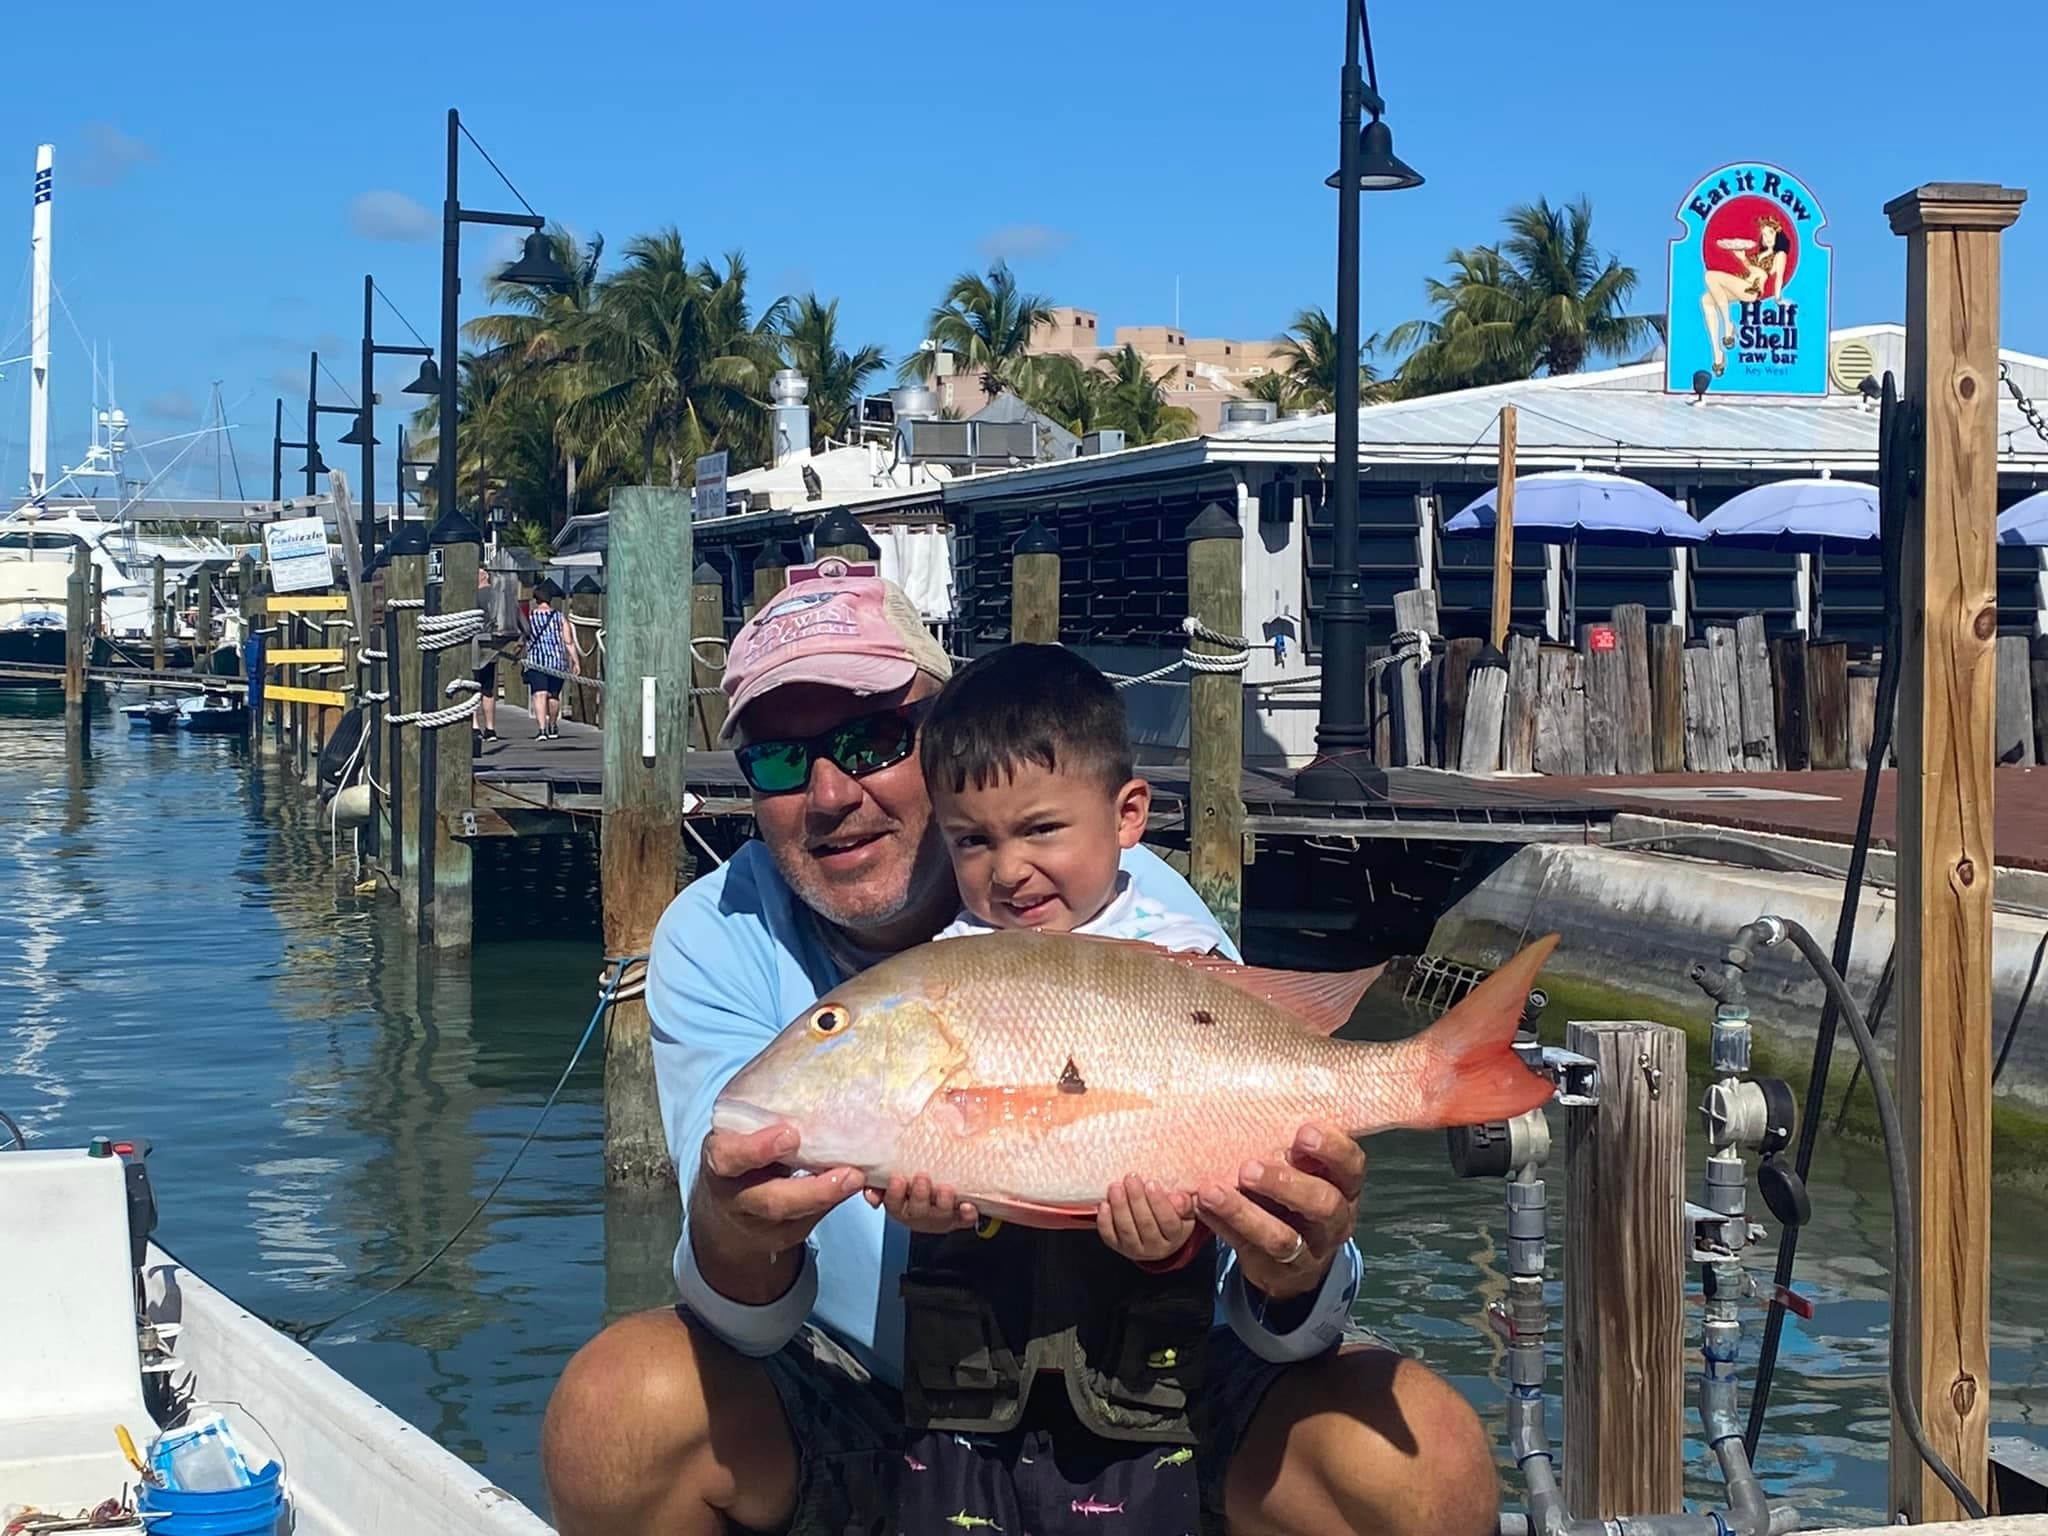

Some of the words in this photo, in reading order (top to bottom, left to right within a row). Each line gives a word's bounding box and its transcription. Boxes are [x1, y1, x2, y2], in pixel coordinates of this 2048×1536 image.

[1688, 179, 1732, 221] Eat
[1735, 170, 1756, 192] it
[1762, 171, 1812, 222] Raw
[1739, 300, 1798, 327] Half
[1739, 325, 1798, 350] Shell
[1739, 352, 1768, 364] raw
[1771, 350, 1798, 365] bar
[1745, 365, 1762, 377] Key
[791, 604, 857, 627] WEST
